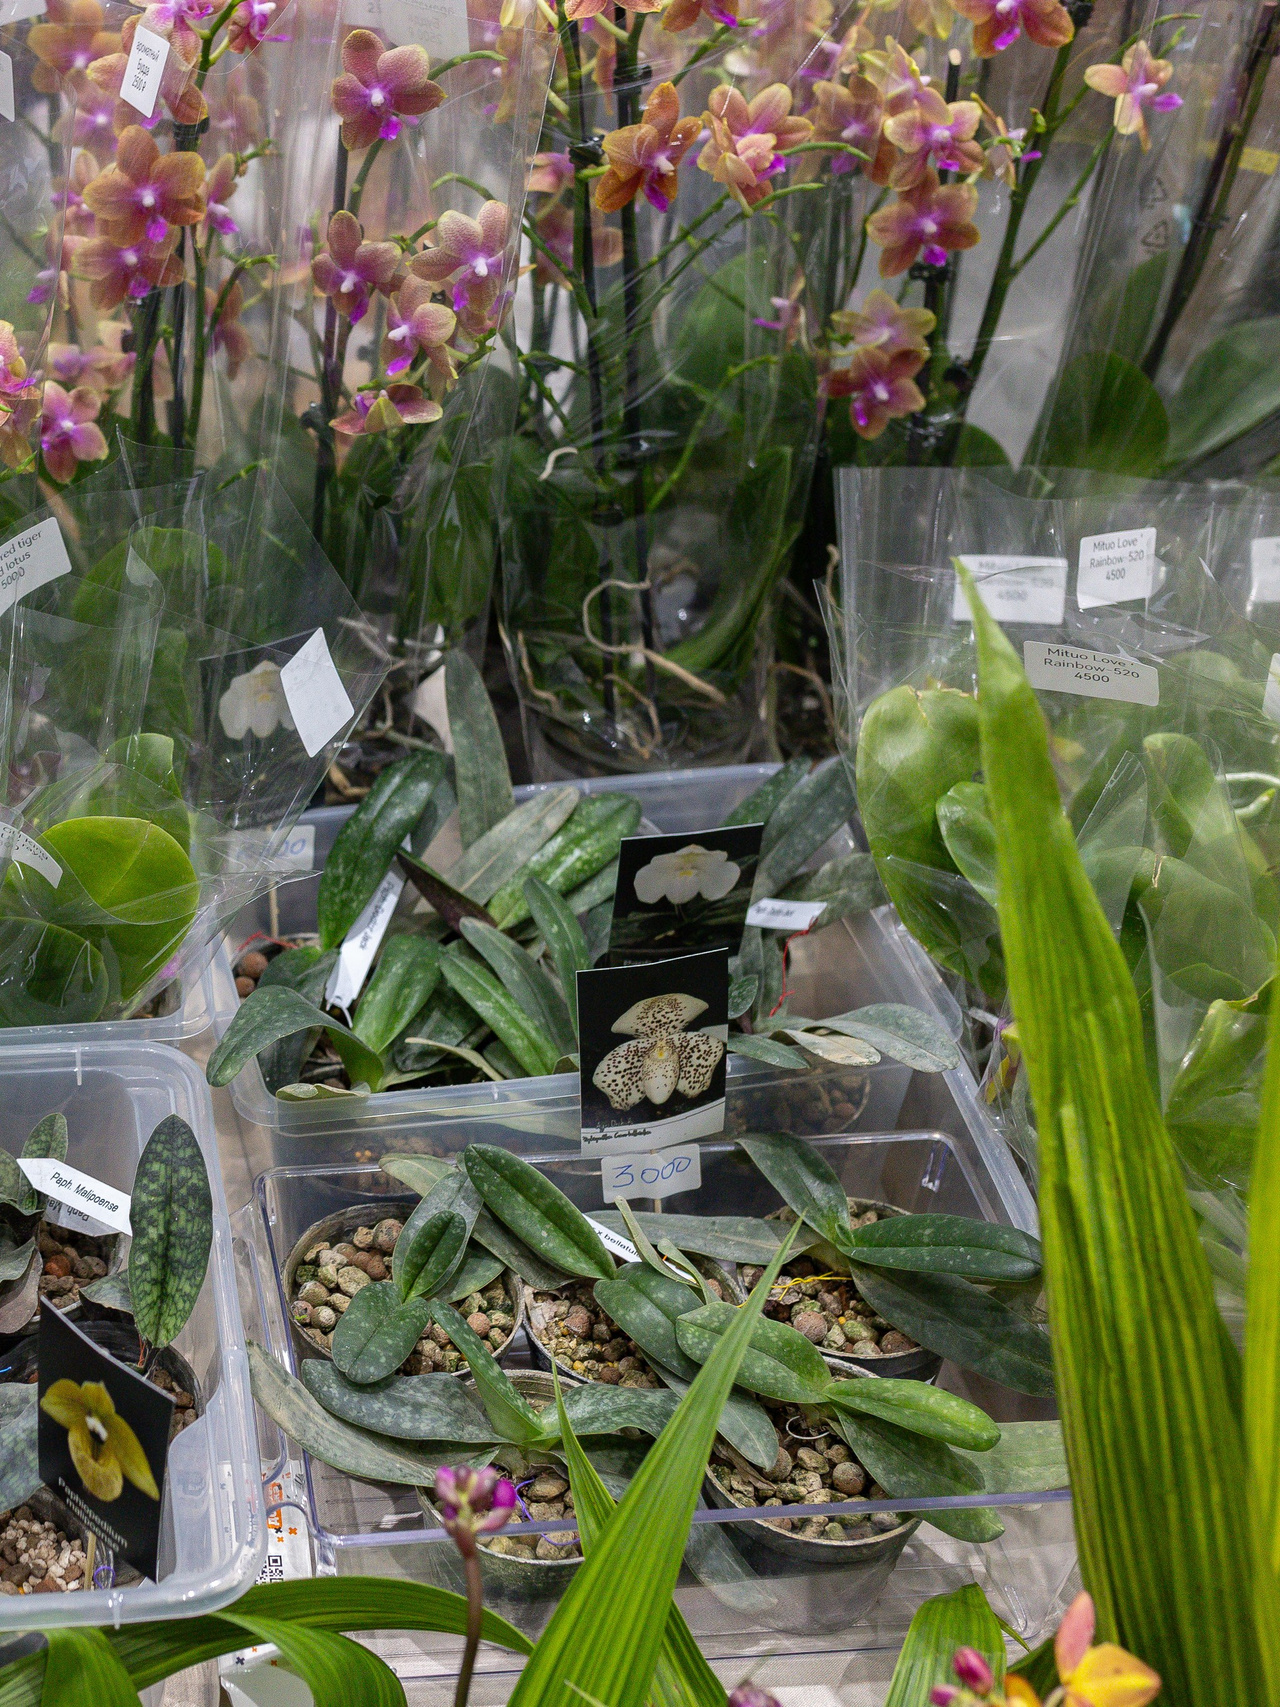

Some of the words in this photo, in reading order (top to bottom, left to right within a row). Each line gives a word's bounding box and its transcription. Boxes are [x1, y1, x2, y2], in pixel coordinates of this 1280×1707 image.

[0, 544, 16, 560] red
[17, 530, 42, 549] tiger
[1093, 540, 1116, 552] Mituo
[1117, 537, 1138, 549] Love
[6, 551, 31, 571] lotus
[1, 566, 26, 590] 5000
[1105, 568, 1126, 581] 4500
[1047, 647, 1089, 660] Mituo
[1093, 654, 1126, 667] Love
[1043, 658, 1140, 679] Rainbow-520
[1074, 671, 1110, 683] 4500
[611, 1156, 692, 1188] 3000
[50, 1171, 72, 1191] Paph.
[73, 1183, 119, 1213] Malipoense
[58, 1476, 128, 1549] Paphiopedilum
[66, 1496, 120, 1553] malipoense
